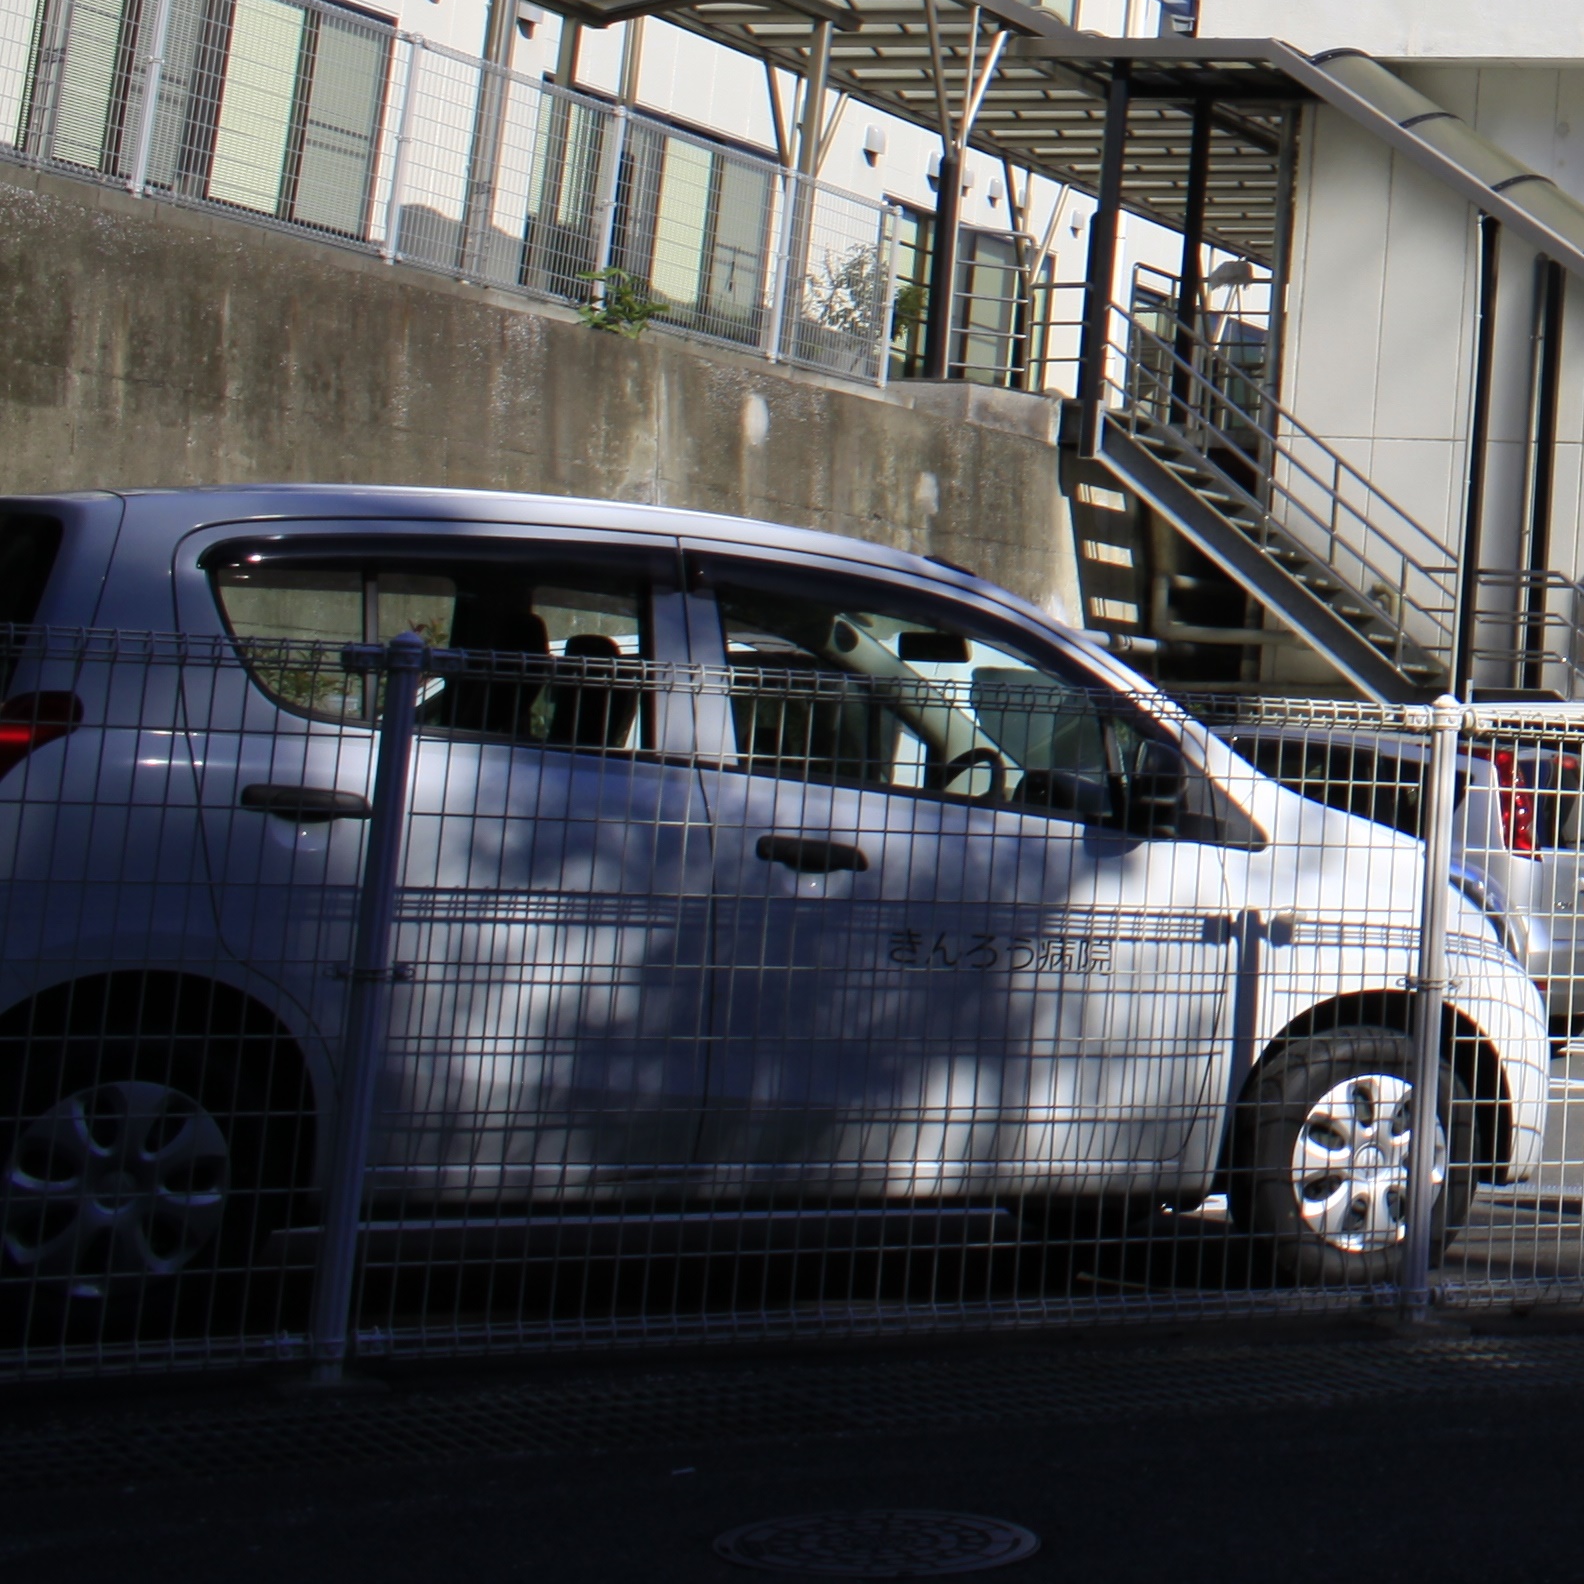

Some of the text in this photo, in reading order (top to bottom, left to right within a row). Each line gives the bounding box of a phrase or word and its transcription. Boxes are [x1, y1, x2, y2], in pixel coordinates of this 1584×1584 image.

[888, 927, 1115, 976] きんろう病院
